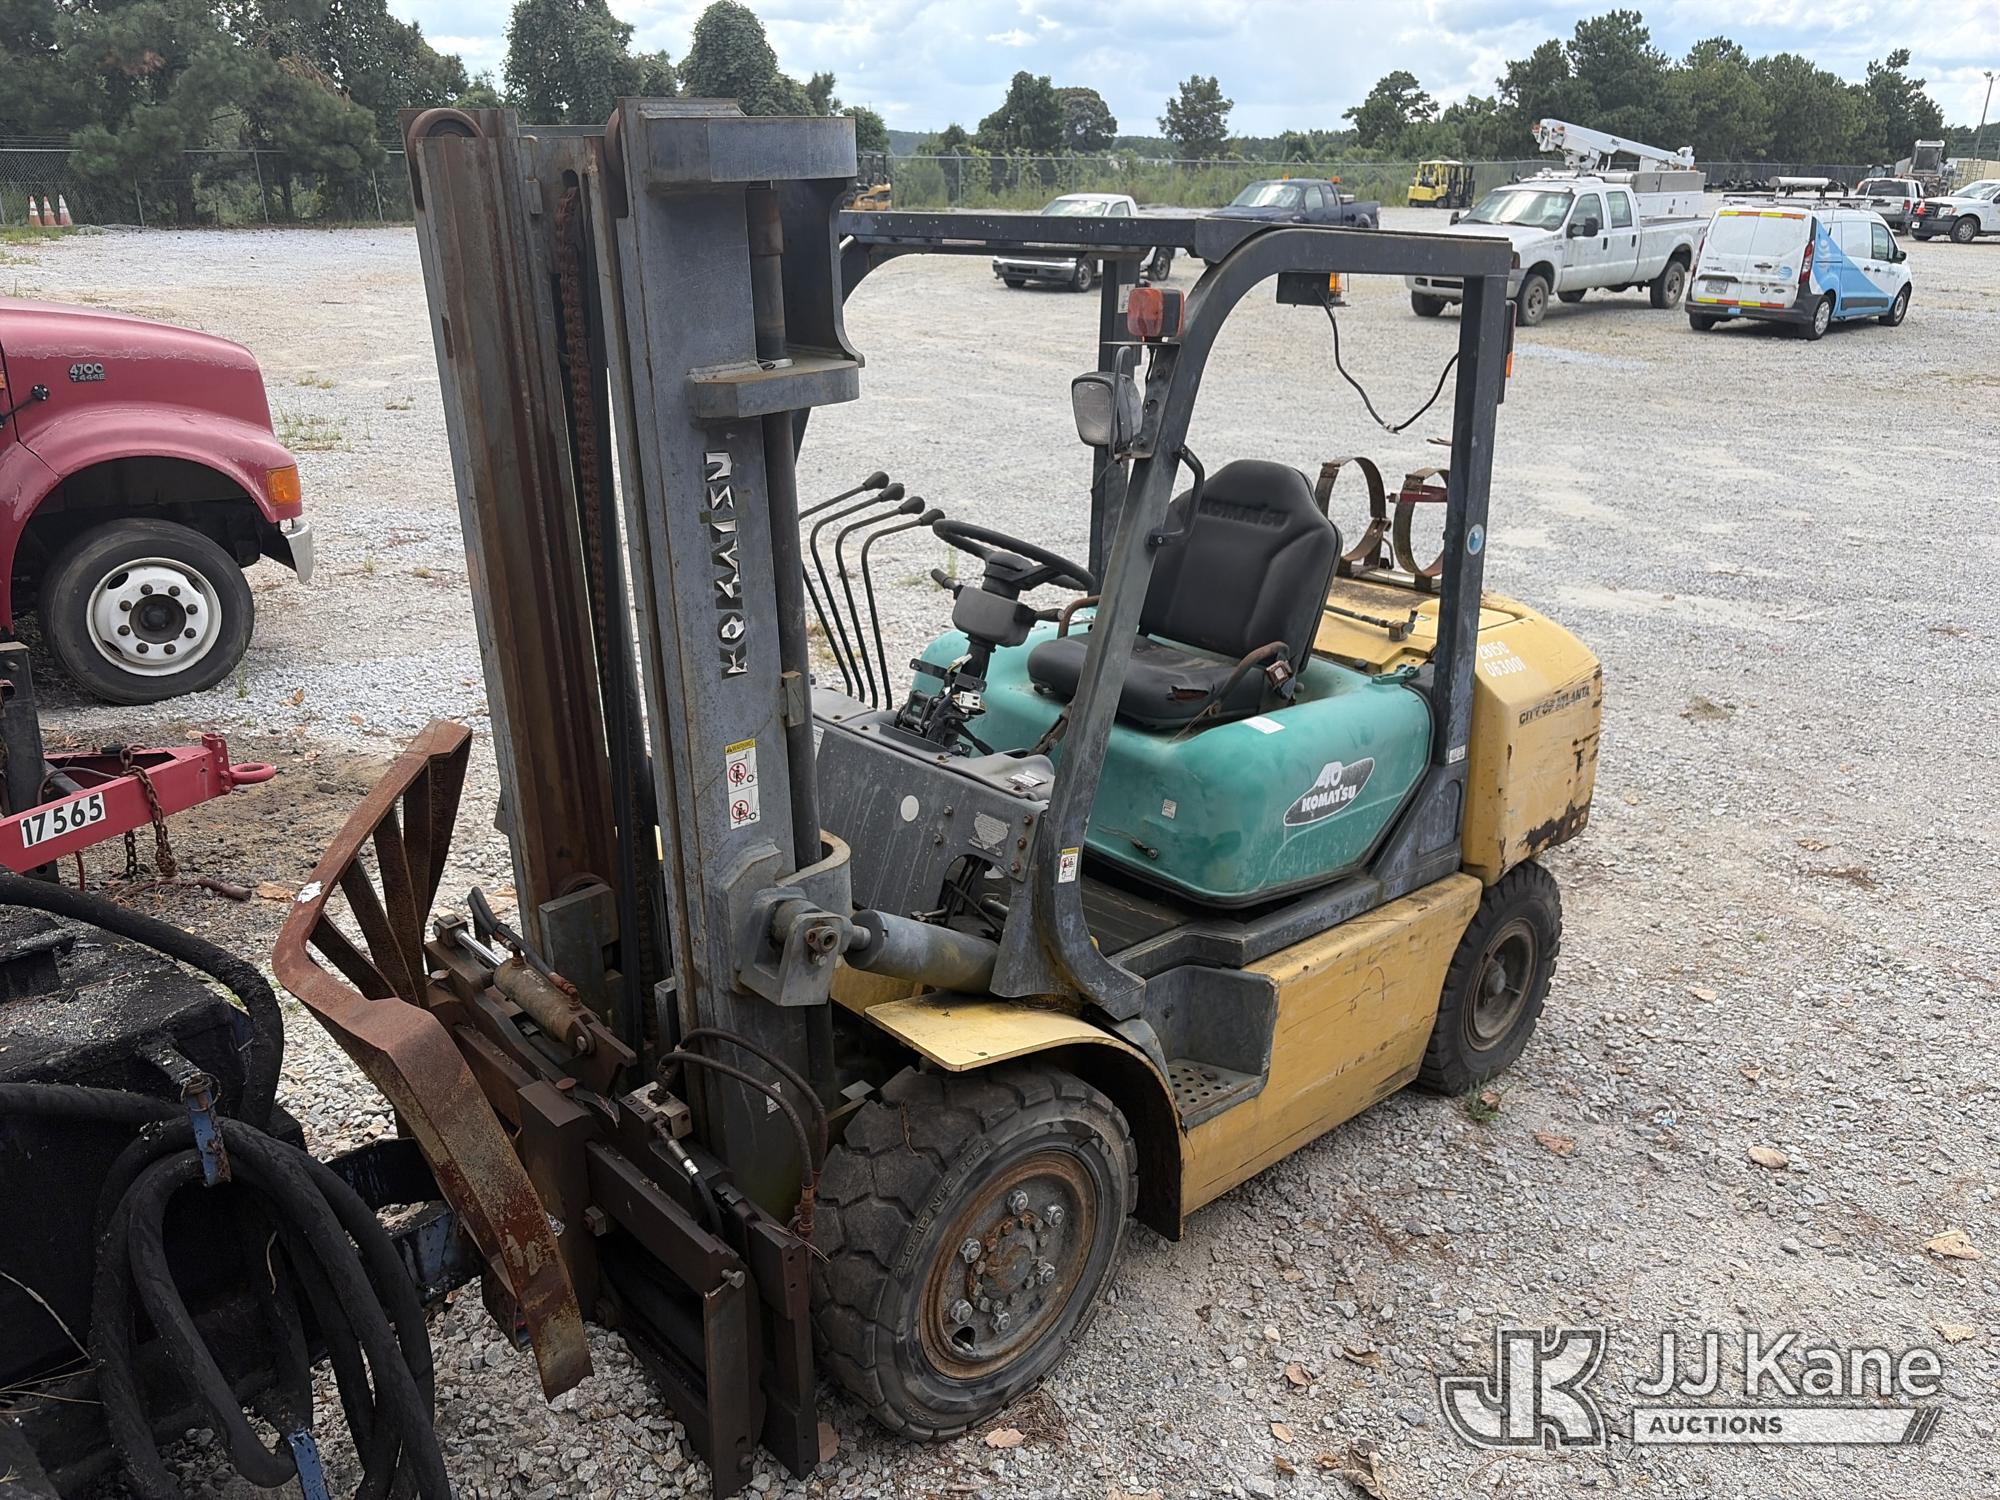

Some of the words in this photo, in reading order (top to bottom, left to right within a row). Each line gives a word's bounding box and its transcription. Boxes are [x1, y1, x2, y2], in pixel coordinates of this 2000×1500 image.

[69, 363, 104, 375] 4700
[1301, 784, 1357, 813] KOMATSU
[22, 794, 103, 846] 17565
